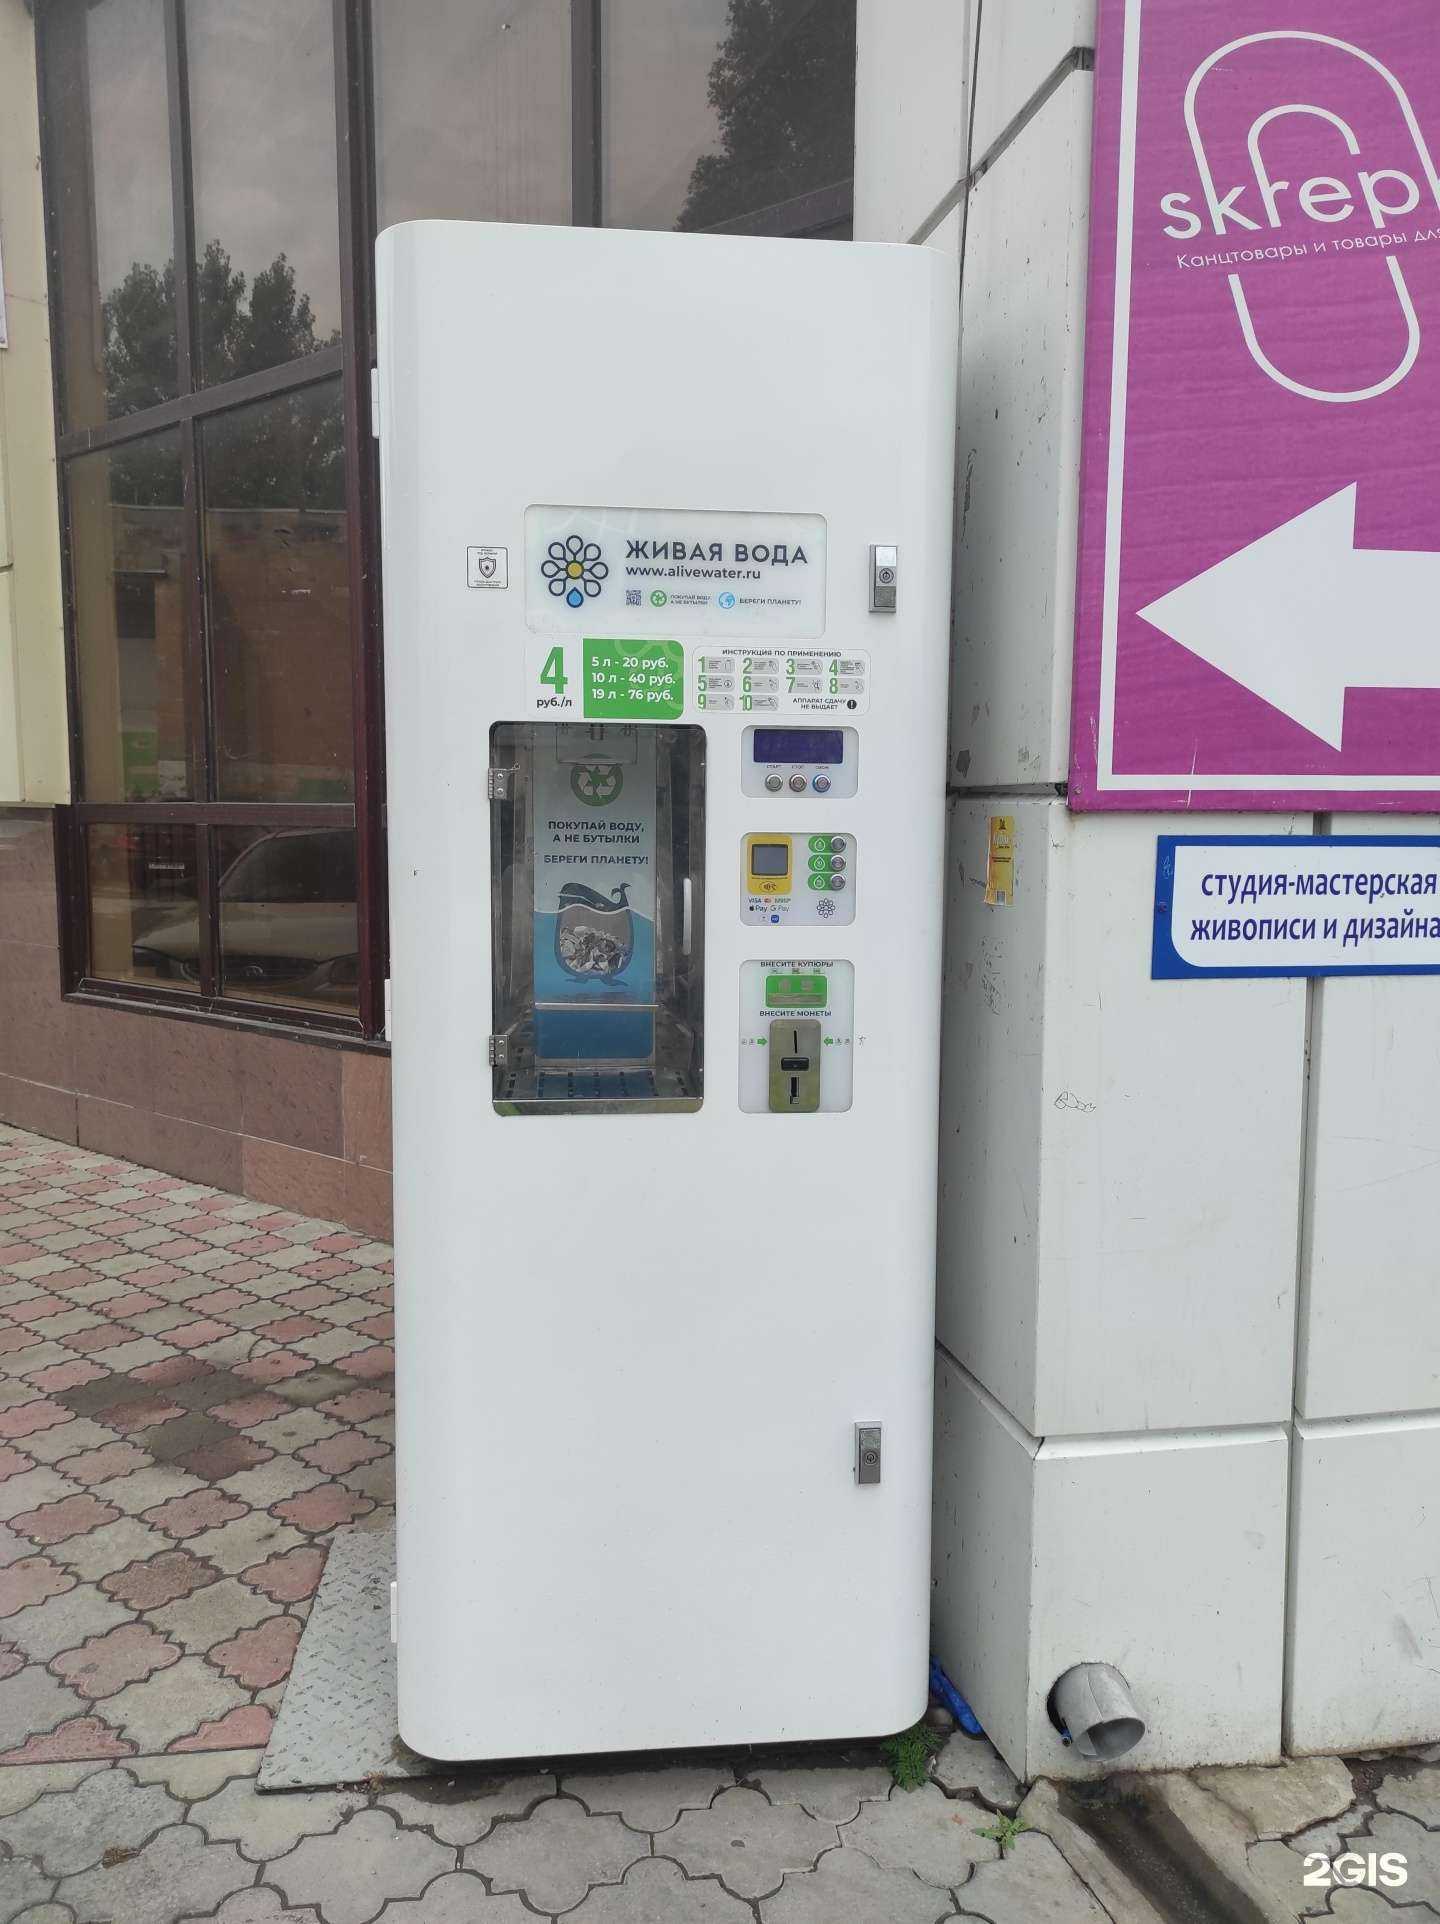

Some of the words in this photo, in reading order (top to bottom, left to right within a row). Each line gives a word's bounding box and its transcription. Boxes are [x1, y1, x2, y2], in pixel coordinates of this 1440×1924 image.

[1176, 241, 1308, 269] Канцтовары
[1313, 241, 1327, 253] и
[1332, 231, 1407, 251] товары
[626, 540, 723, 562] ЖИВАЯ
[735, 543, 808, 567] ВОДА
[626, 565, 761, 579] www.alivewater.ru
[540, 646, 568, 694] 4
[591, 656, 599, 667] 5
[602, 658, 611, 667] л
[622, 657, 639, 668] 20
[642, 656, 669, 670] руб.
[698, 656, 705, 673] 1
[743, 657, 753, 674] 2
[786, 658, 795, 675] 3
[829, 659, 839, 676] 4
[592, 672, 605, 683] 10
[608, 674, 617, 683] л
[628, 673, 646, 684] 40
[649, 673, 676, 686] руб.
[698, 675, 707, 692] 5
[743, 676, 752, 692] 6
[786, 676, 795, 694] 7
[829, 677, 839, 694] 8
[536, 696, 573, 709] руб./л
[592, 688, 605, 699] 19
[607, 690, 617, 699] л
[628, 689, 644, 700] 76
[646, 689, 674, 702] руб.
[698, 693, 707, 710] 9
[739, 694, 753, 711] 10
[548, 820, 606, 831] ПОКУПАЙ
[609, 822, 645, 833] ВОДУ,
[552, 834, 561, 843] А
[564, 834, 580, 843] НЕ
[583, 835, 640, 844] БУТЫЛКИ
[544, 854, 588, 864] БЕРЕГИ
[591, 855, 649, 865] ПЛАНЕТУ!
[1201, 873, 1438, 904] студия-мастерская
[1190, 917, 1316, 941] живописи
[1323, 918, 1337, 940] и
